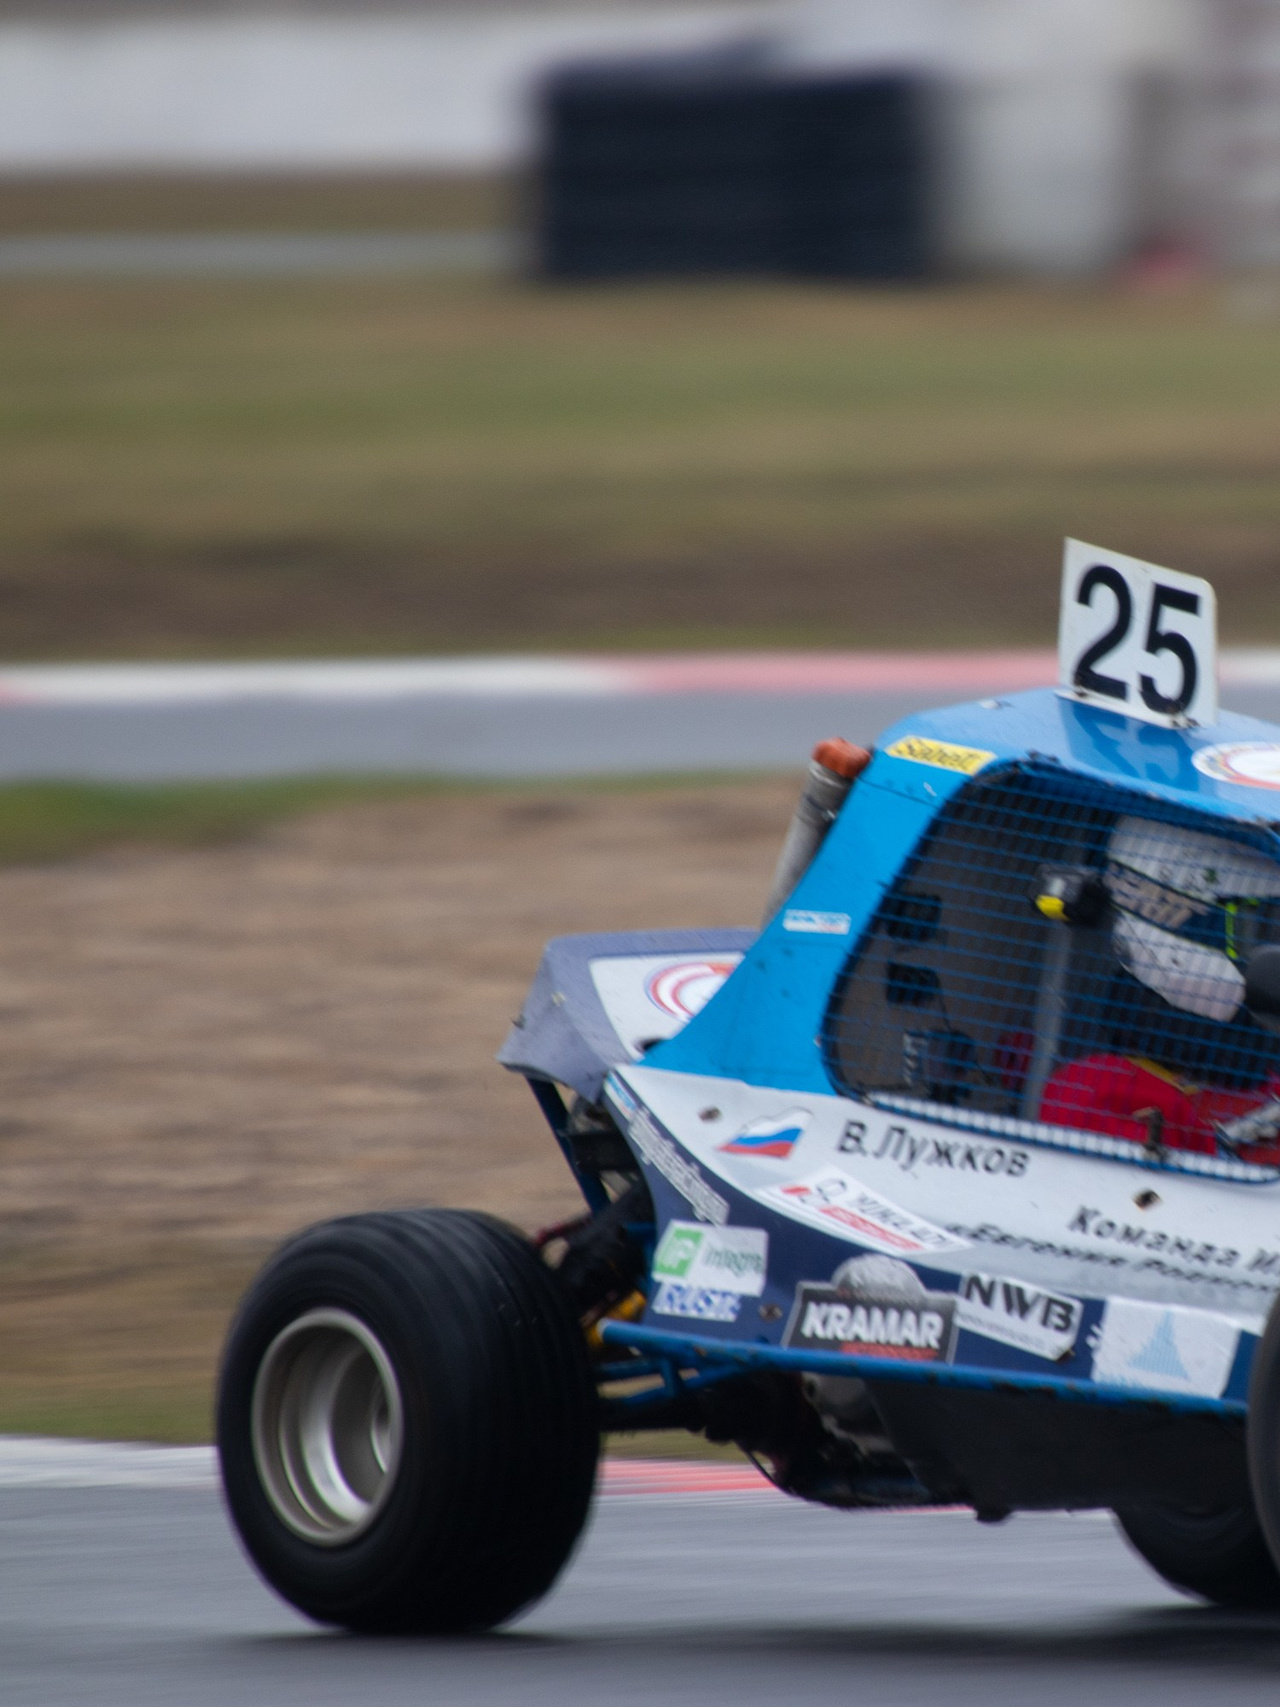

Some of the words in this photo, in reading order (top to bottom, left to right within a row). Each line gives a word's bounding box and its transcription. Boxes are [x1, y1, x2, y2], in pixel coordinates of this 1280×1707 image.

[1073, 564, 1201, 715] 25
[837, 1119, 1030, 1178] В.Лужков
[1067, 1204, 1240, 1269] Команда
[801, 1301, 944, 1350] KRAMAR
[964, 1275, 1076, 1332] NWB
